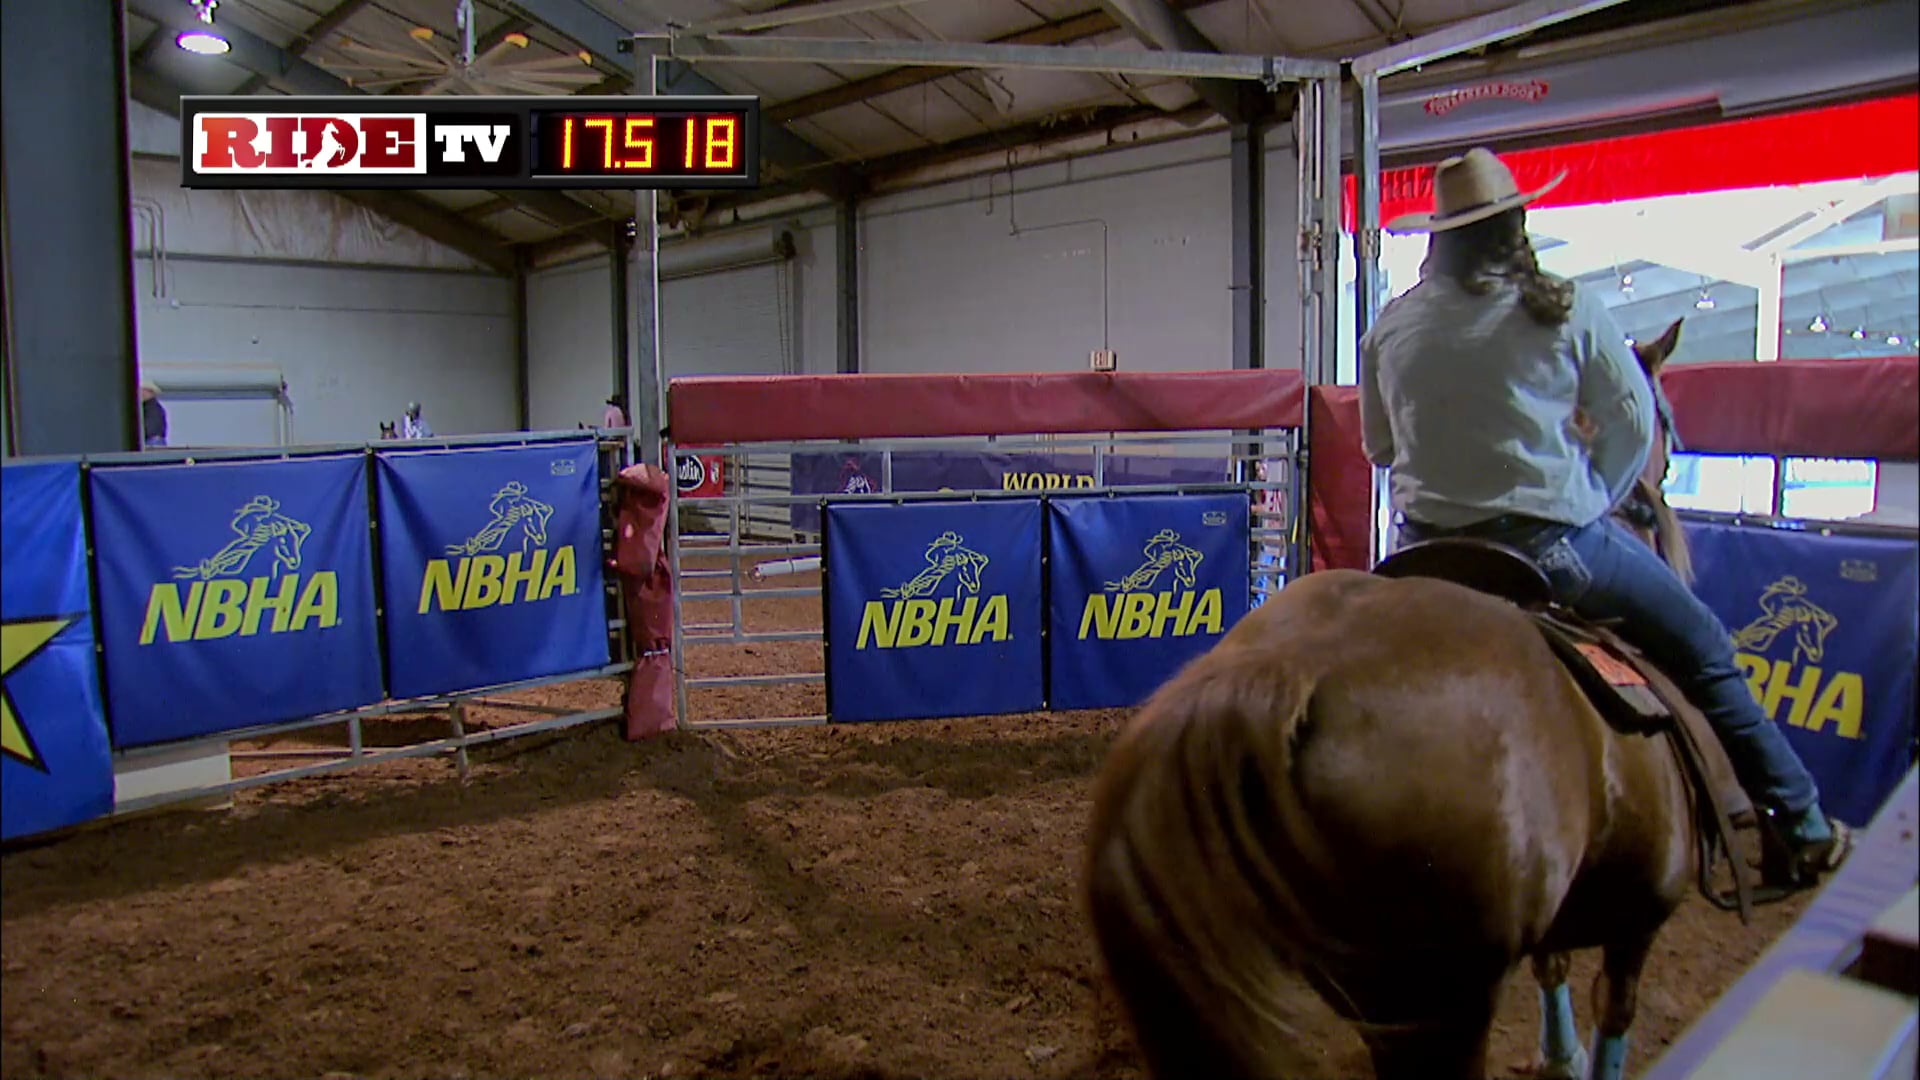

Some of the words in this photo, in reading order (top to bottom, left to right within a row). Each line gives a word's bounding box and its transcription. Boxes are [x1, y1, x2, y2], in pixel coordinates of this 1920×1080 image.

[139, 571, 339, 645] NBHA
[418, 545, 578, 614] NBHA
[1078, 588, 1224, 640] NBHA
[856, 594, 1009, 650] NBHA
[1733, 652, 1864, 739] BHA
